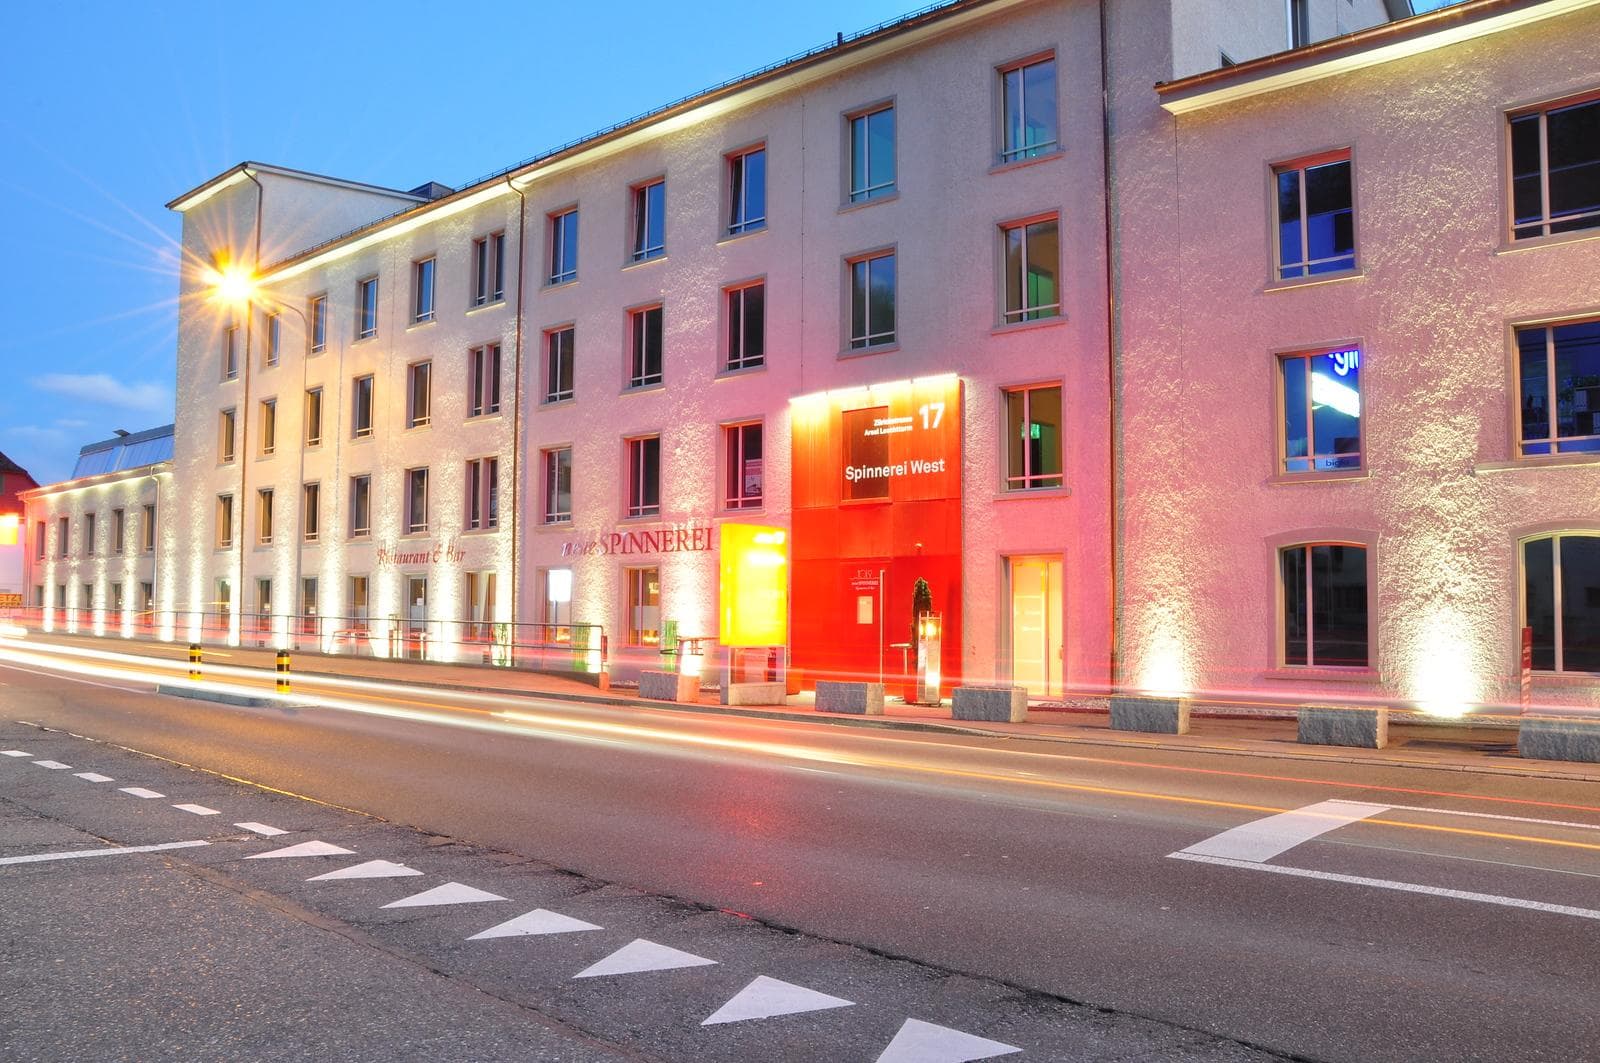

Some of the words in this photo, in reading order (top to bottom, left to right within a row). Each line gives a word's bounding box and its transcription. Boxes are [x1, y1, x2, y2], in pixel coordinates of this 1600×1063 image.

[919, 402, 945, 429] 17
[845, 461, 907, 482] Spinnerei
[910, 459, 945, 474] West
[598, 527, 713, 556] SPINNEREI
